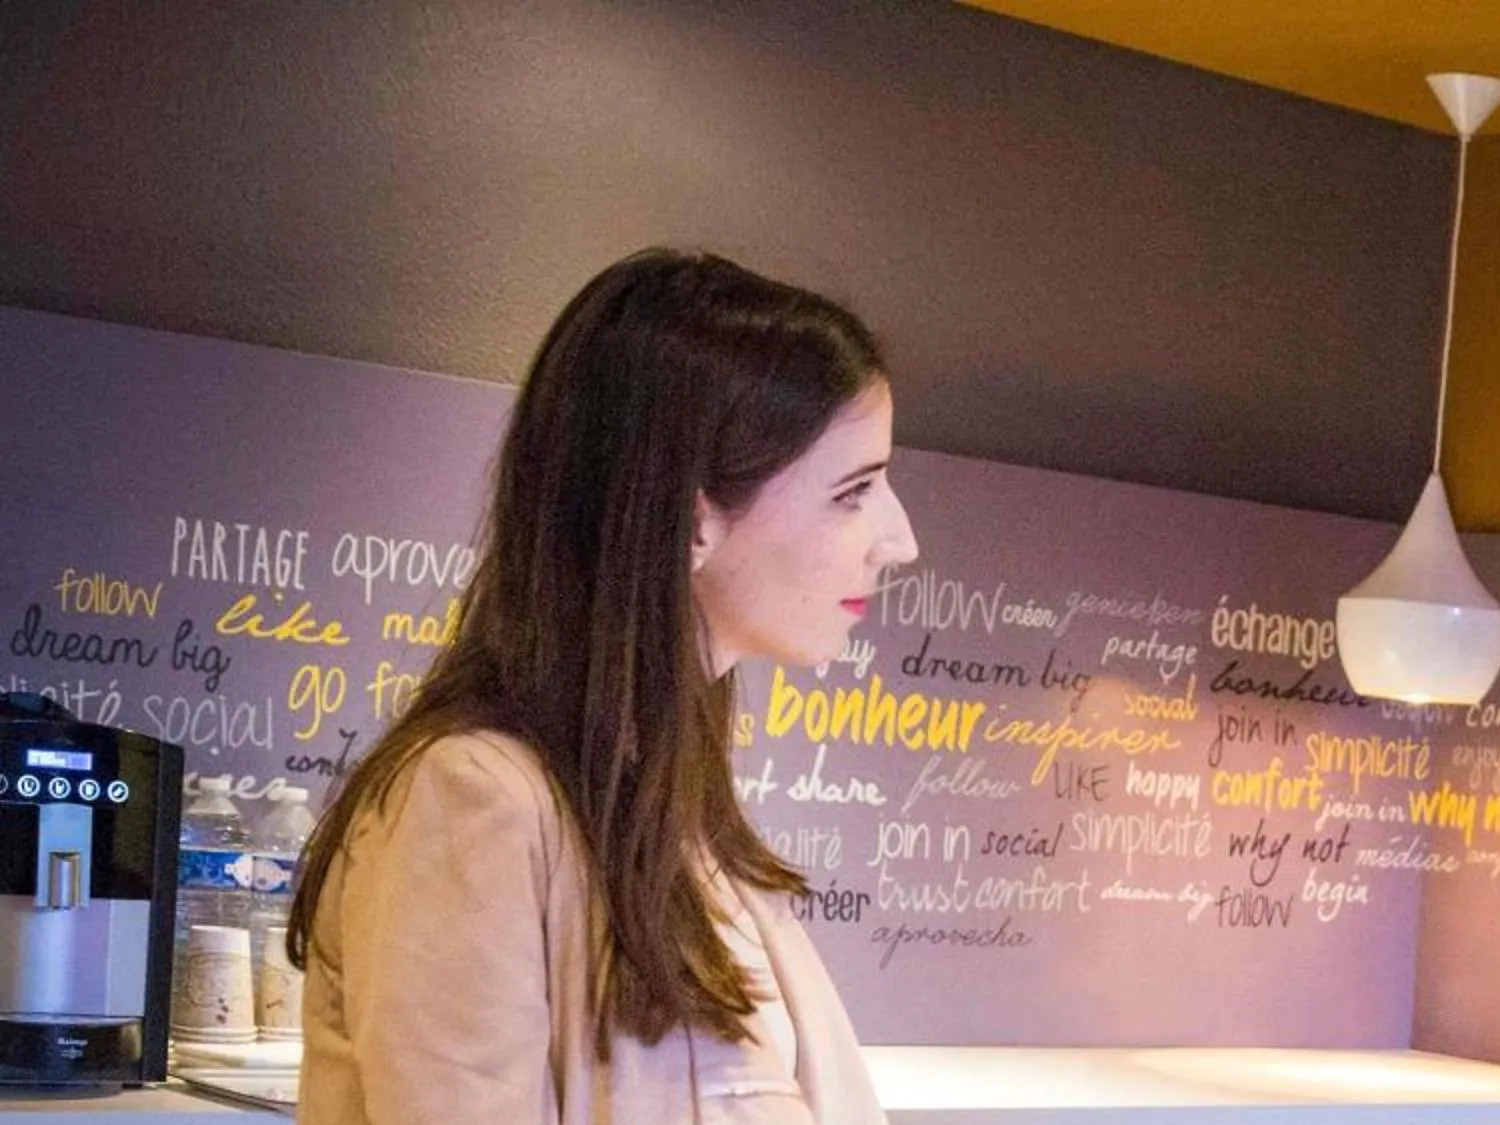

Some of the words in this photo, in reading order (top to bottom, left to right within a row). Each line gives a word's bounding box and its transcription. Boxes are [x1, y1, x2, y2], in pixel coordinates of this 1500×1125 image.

[171, 516, 310, 590] PARTAGE
[332, 532, 476, 606] aprove
[54, 568, 163, 619] follow
[215, 593, 351, 646] like
[880, 560, 1006, 634] follow
[10, 603, 158, 658] dream
[171, 617, 231, 693] big
[1100, 629, 1199, 686] partage
[1211, 594, 1336, 669] échange
[288, 663, 347, 741] go
[902, 632, 1032, 688] dream
[1041, 647, 1092, 714] big
[1123, 672, 1198, 721] social
[143, 693, 273, 749] social
[766, 664, 989, 754] bonheur
[1208, 702, 1264, 768] join
[1274, 708, 1297, 747] in
[785, 743, 887, 805] share
[983, 702, 1183, 788] inspirer
[1304, 731, 1431, 796] simplicité
[901, 752, 1022, 814] follow
[1053, 759, 1112, 801] LIKE
[1125, 759, 1202, 812] happy
[866, 811, 931, 868] join
[942, 813, 971, 863] in
[980, 822, 1065, 859] social
[1069, 806, 1214, 876] simplicité
[1313, 794, 1374, 833] join
[1377, 796, 1409, 823] in
[1408, 781, 1477, 848] why
[1228, 817, 1292, 888] why
[1302, 822, 1353, 864] not
[877, 860, 971, 914] trust
[1214, 884, 1295, 930] follow
[1302, 866, 1369, 924] begin
[869, 914, 1034, 971] aprovecha
